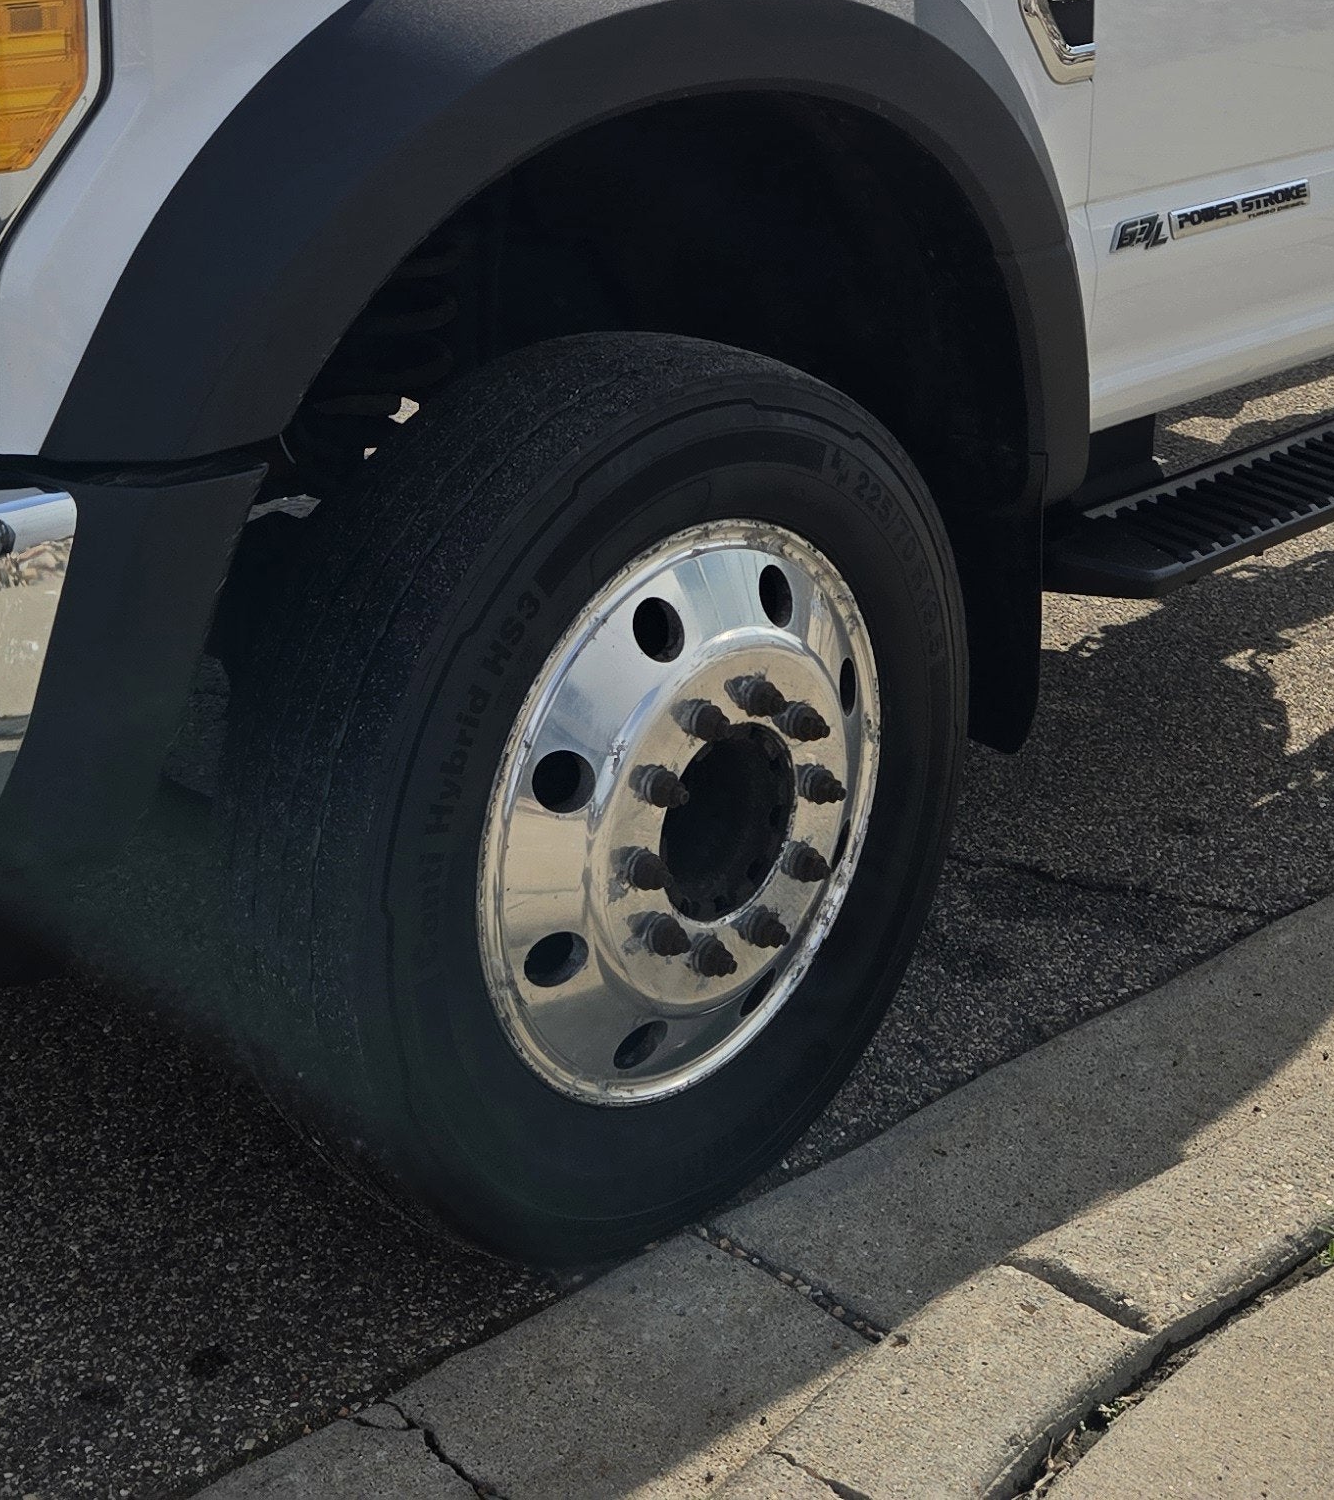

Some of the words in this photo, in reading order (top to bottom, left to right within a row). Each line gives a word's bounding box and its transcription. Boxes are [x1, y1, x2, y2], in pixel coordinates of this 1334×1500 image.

[1177, 202, 1239, 230] POWER
[1242, 183, 1308, 213] STROKE
[425, 682, 492, 836] Hybrid
[481, 590, 542, 678] HS3
